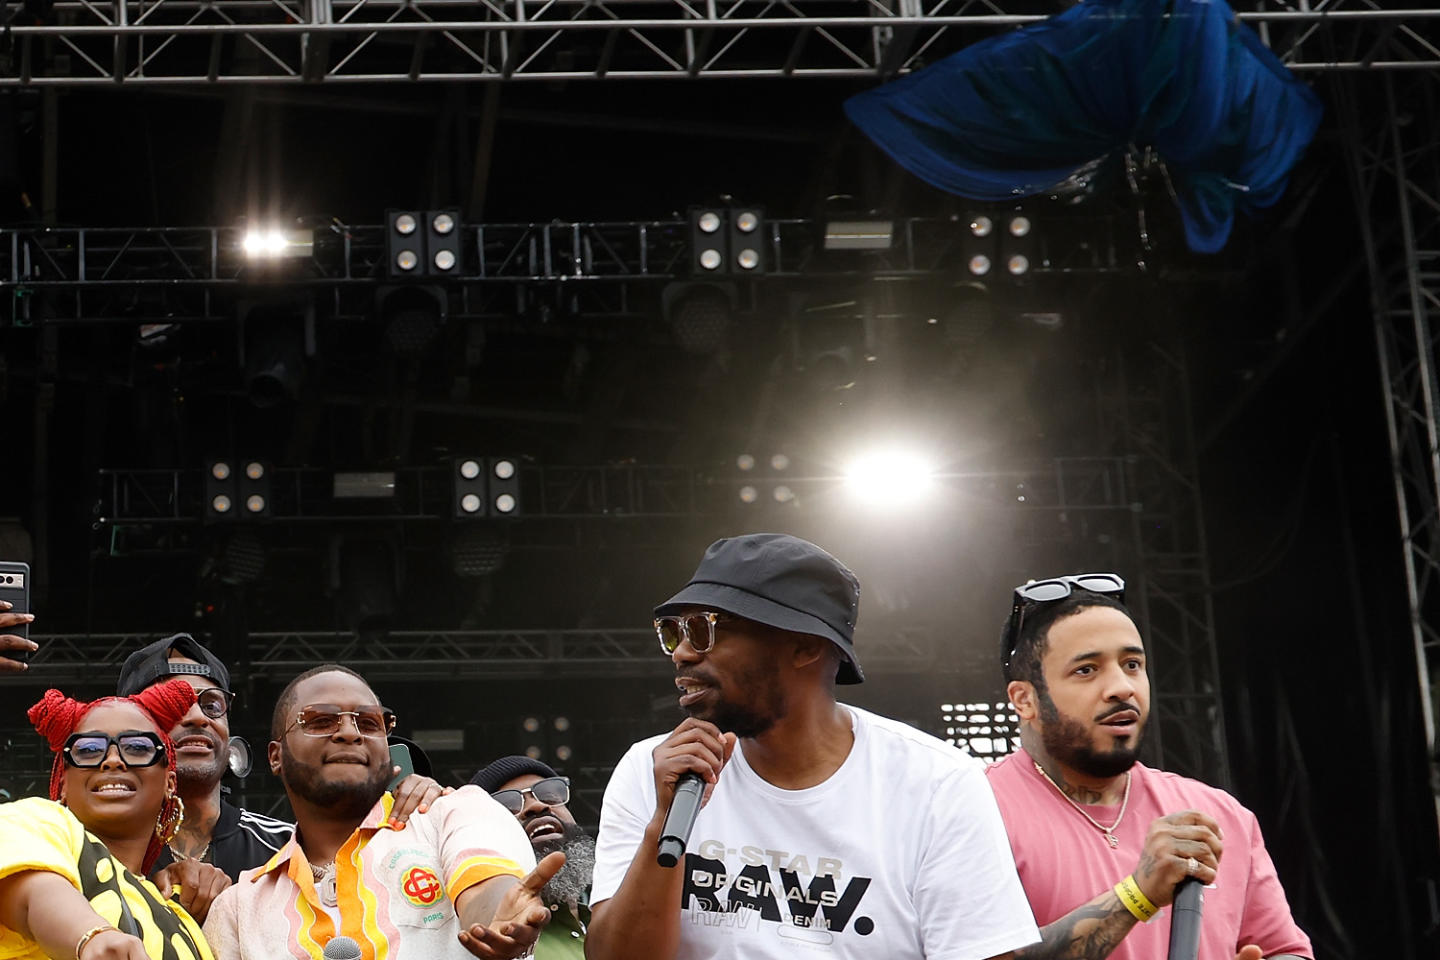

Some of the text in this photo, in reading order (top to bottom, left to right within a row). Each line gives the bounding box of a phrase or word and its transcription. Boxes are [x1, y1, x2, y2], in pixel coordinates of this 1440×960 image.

[698, 840, 843, 880] G-STAR
[692, 870, 838, 907] ORIGINALS
[423, 912, 445, 924] PARIS
[784, 912, 832, 930] DENIM
